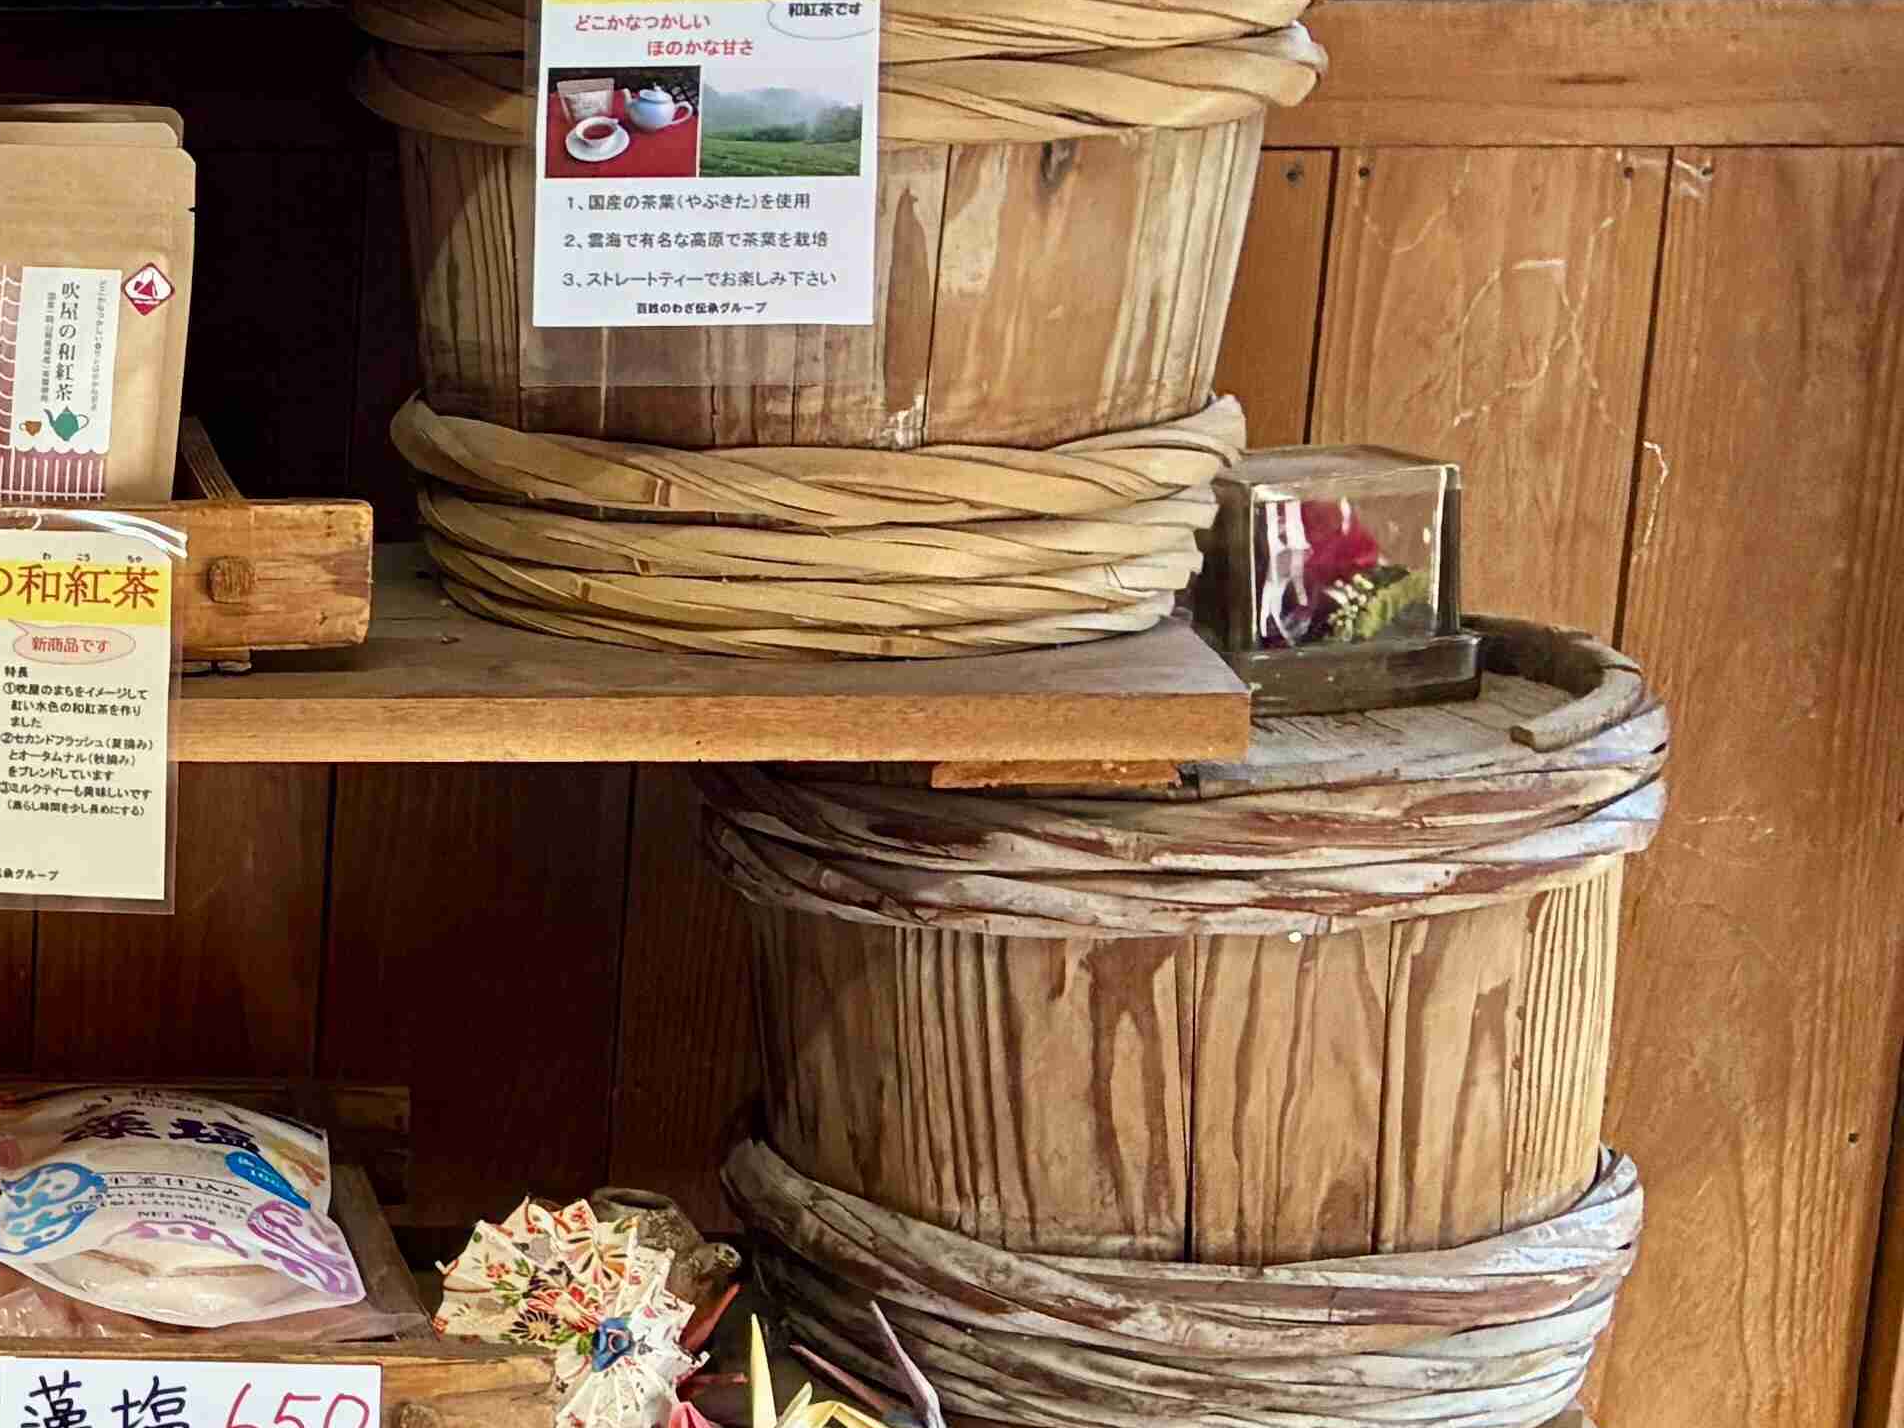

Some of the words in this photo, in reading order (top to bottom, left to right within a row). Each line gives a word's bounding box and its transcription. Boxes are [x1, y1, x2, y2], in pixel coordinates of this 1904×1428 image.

[788, 1, 863, 19] 和紅茶です
[574, 12, 712, 33] どこかなつかしい
[646, 39, 755, 58] ほのかな甘さ
[636, 301, 769, 316] 百姓のわざ伝承グループ
[55, 281, 80, 403] 吹屋の和紅茶
[31, 635, 111, 654] 新商品です
[3, 666, 30, 680] 特長
[10, 701, 142, 717] 紅い水色の和紅茶を作り
[10, 716, 43, 730] ました
[7, 765, 115, 782] をブレンドしています
